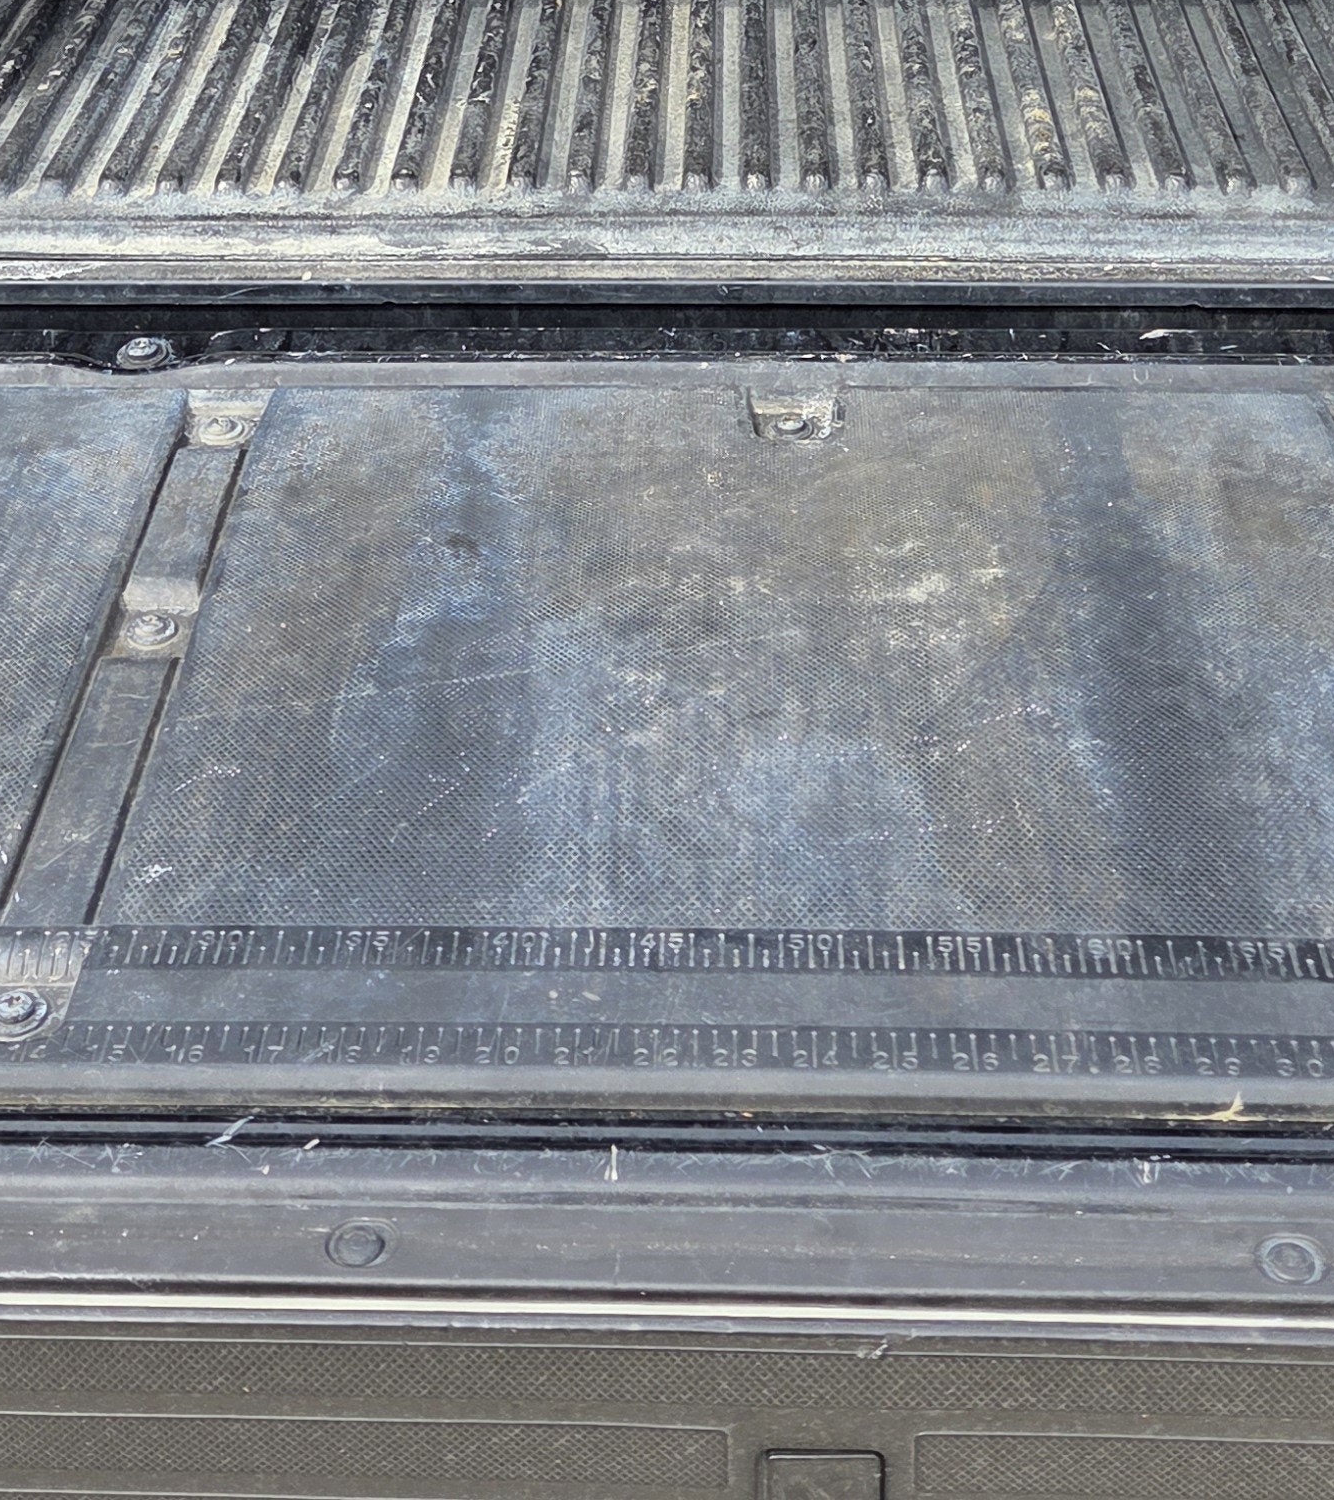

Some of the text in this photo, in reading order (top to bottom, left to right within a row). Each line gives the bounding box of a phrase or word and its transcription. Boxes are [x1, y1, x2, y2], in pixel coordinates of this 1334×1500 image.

[198, 930, 243, 947] 30
[345, 930, 390, 947] 35
[493, 931, 536, 948] 40
[640, 932, 684, 949] 45
[787, 933, 833, 950] 50
[937, 936, 982, 952] 55
[165, 1045, 204, 1063] 16
[244, 1045, 284, 1063] 17
[475, 1046, 519, 1064] 20
[634, 1048, 678, 1066] 22
[713, 1048, 757, 1067] 23
[793, 1050, 838, 1068] 24
[873, 1051, 918, 1070] 25
[953, 1052, 999, 1071] 26
[1033, 1054, 1079, 1074] 27
[1276, 1058, 1323, 1077] 30
